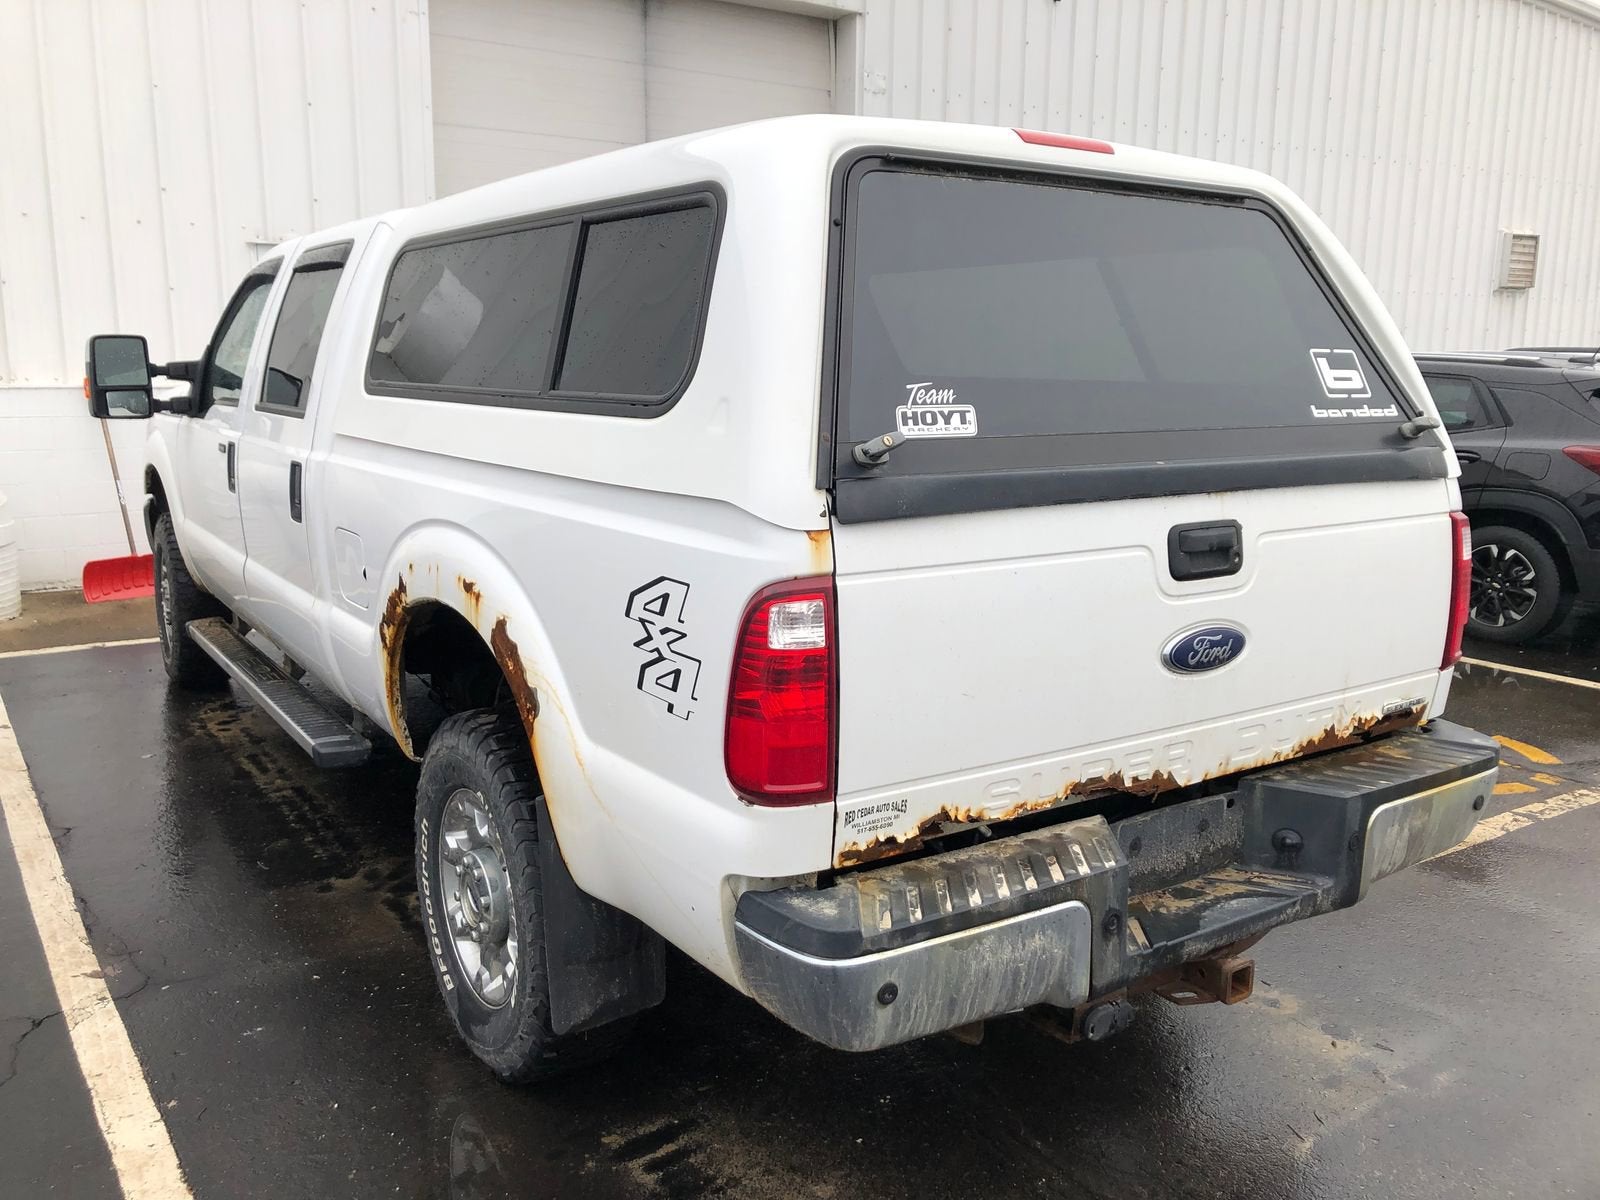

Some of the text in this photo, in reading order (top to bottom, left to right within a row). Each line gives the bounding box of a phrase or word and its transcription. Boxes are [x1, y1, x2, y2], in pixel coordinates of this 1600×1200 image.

[906, 382, 957, 409] Team
[900, 409, 971, 426] HOYT
[1310, 404, 1399, 417] banded
[1188, 634, 1233, 665] Ford
[844, 799, 908, 828] RED CEDAR AUTO SALES
[851, 815, 893, 829] WILLIAMSTON
[421, 817, 455, 991] BFGoodrich
